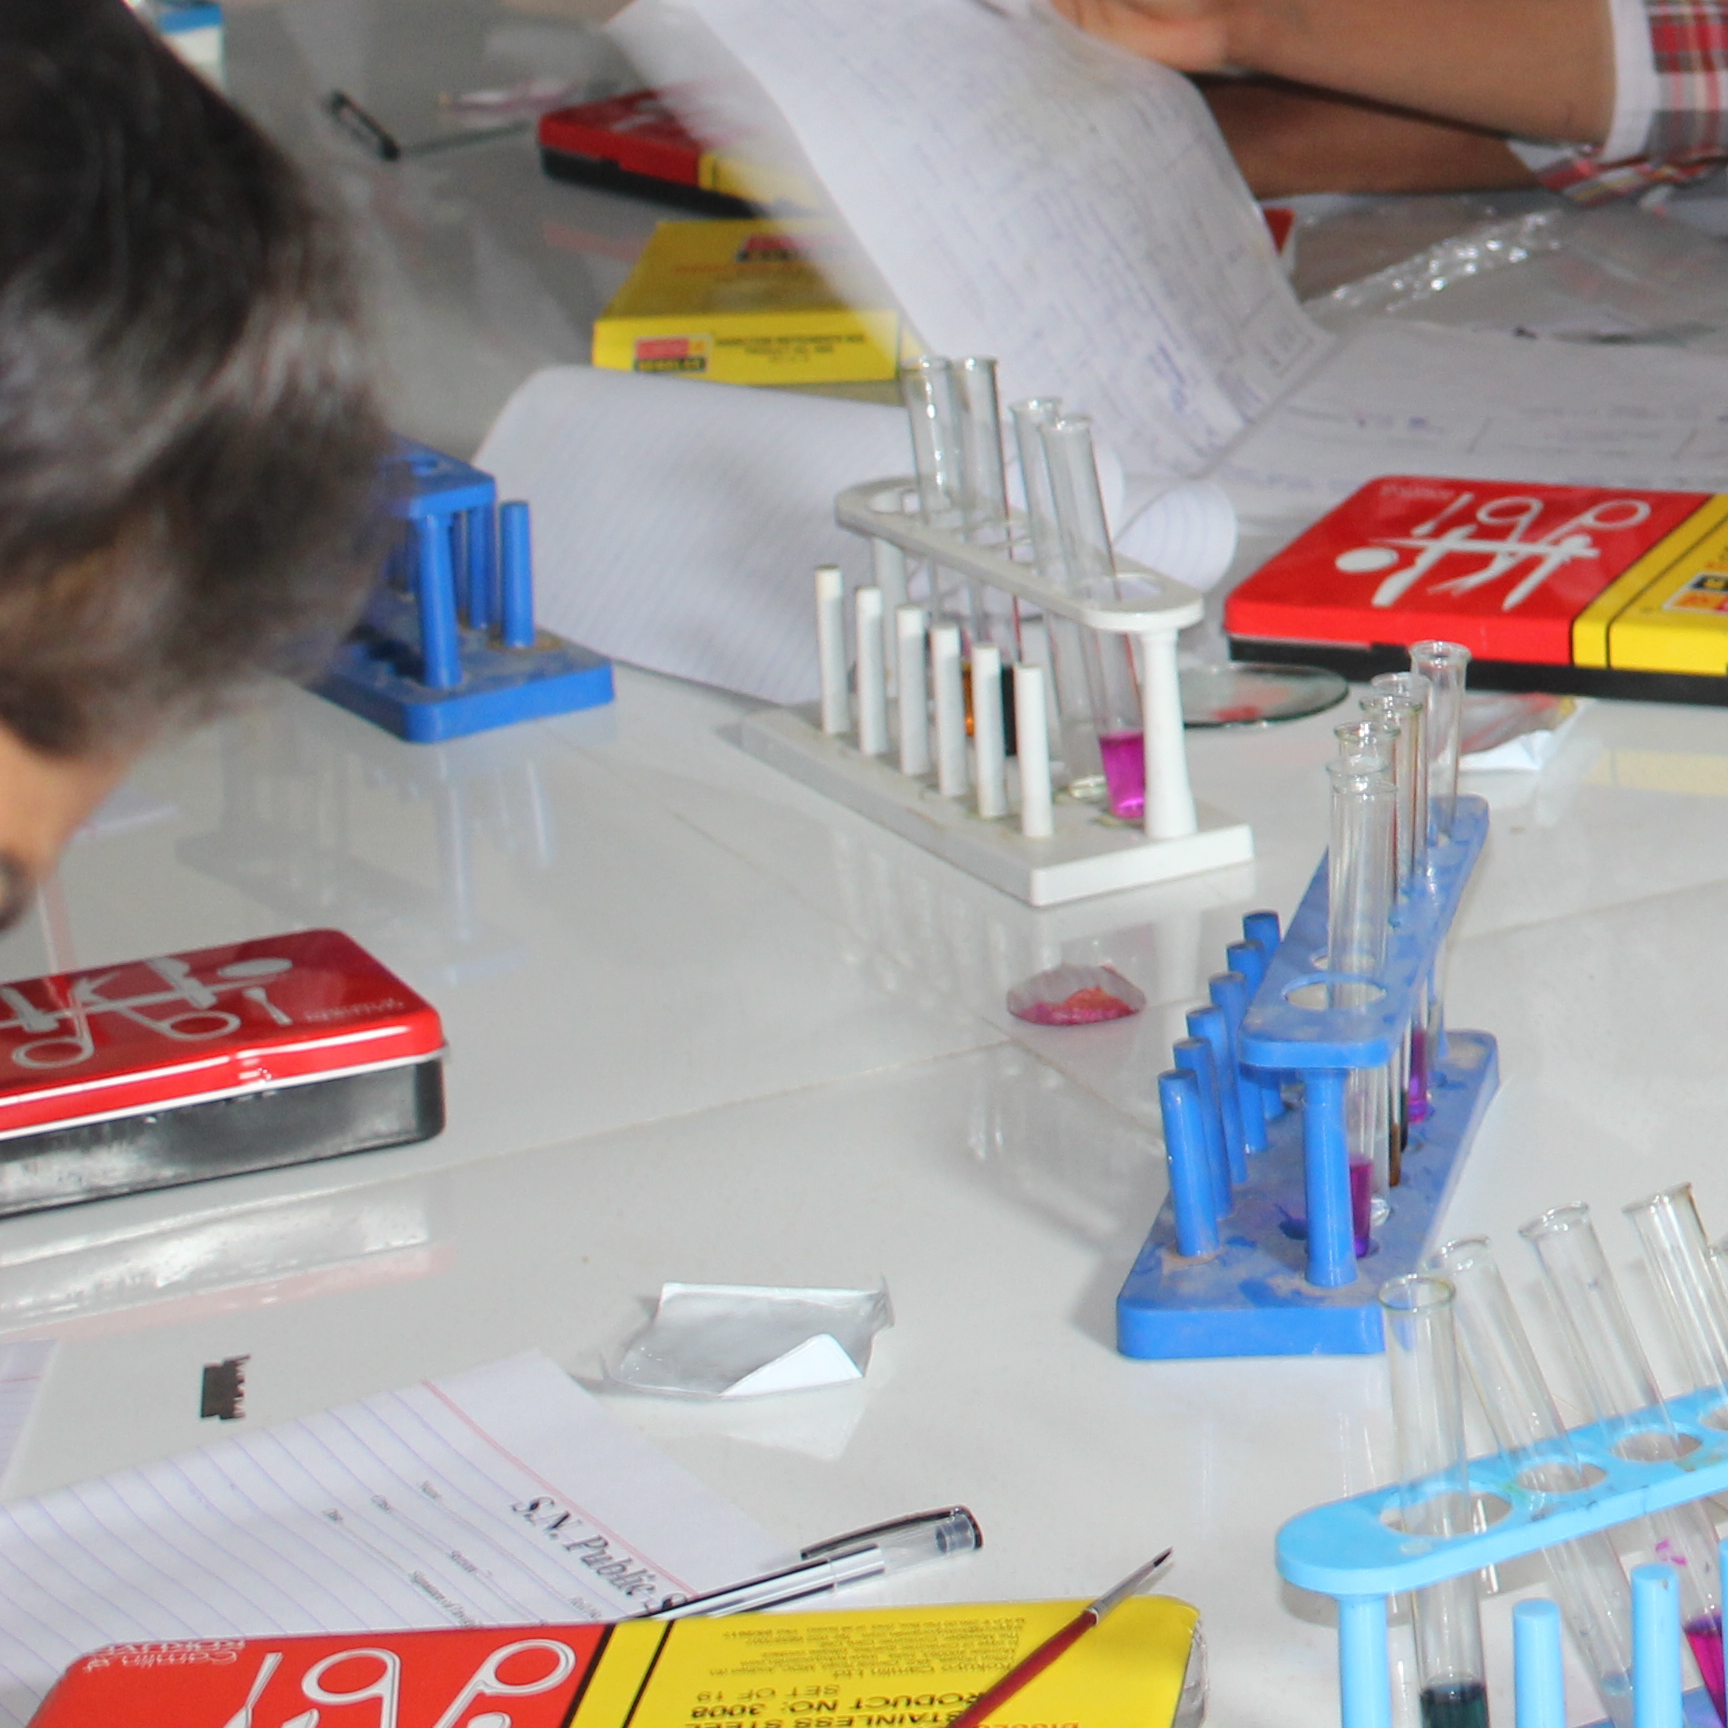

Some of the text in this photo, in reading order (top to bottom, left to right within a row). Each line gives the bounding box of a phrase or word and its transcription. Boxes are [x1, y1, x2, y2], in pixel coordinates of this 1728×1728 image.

[562, 1535, 657, 1597] Public
[738, 1688, 776, 1701] OF
[787, 1684, 840, 1697] SET
[849, 1692, 982, 1711] RODUCT
[690, 1703, 767, 1720] 3008
